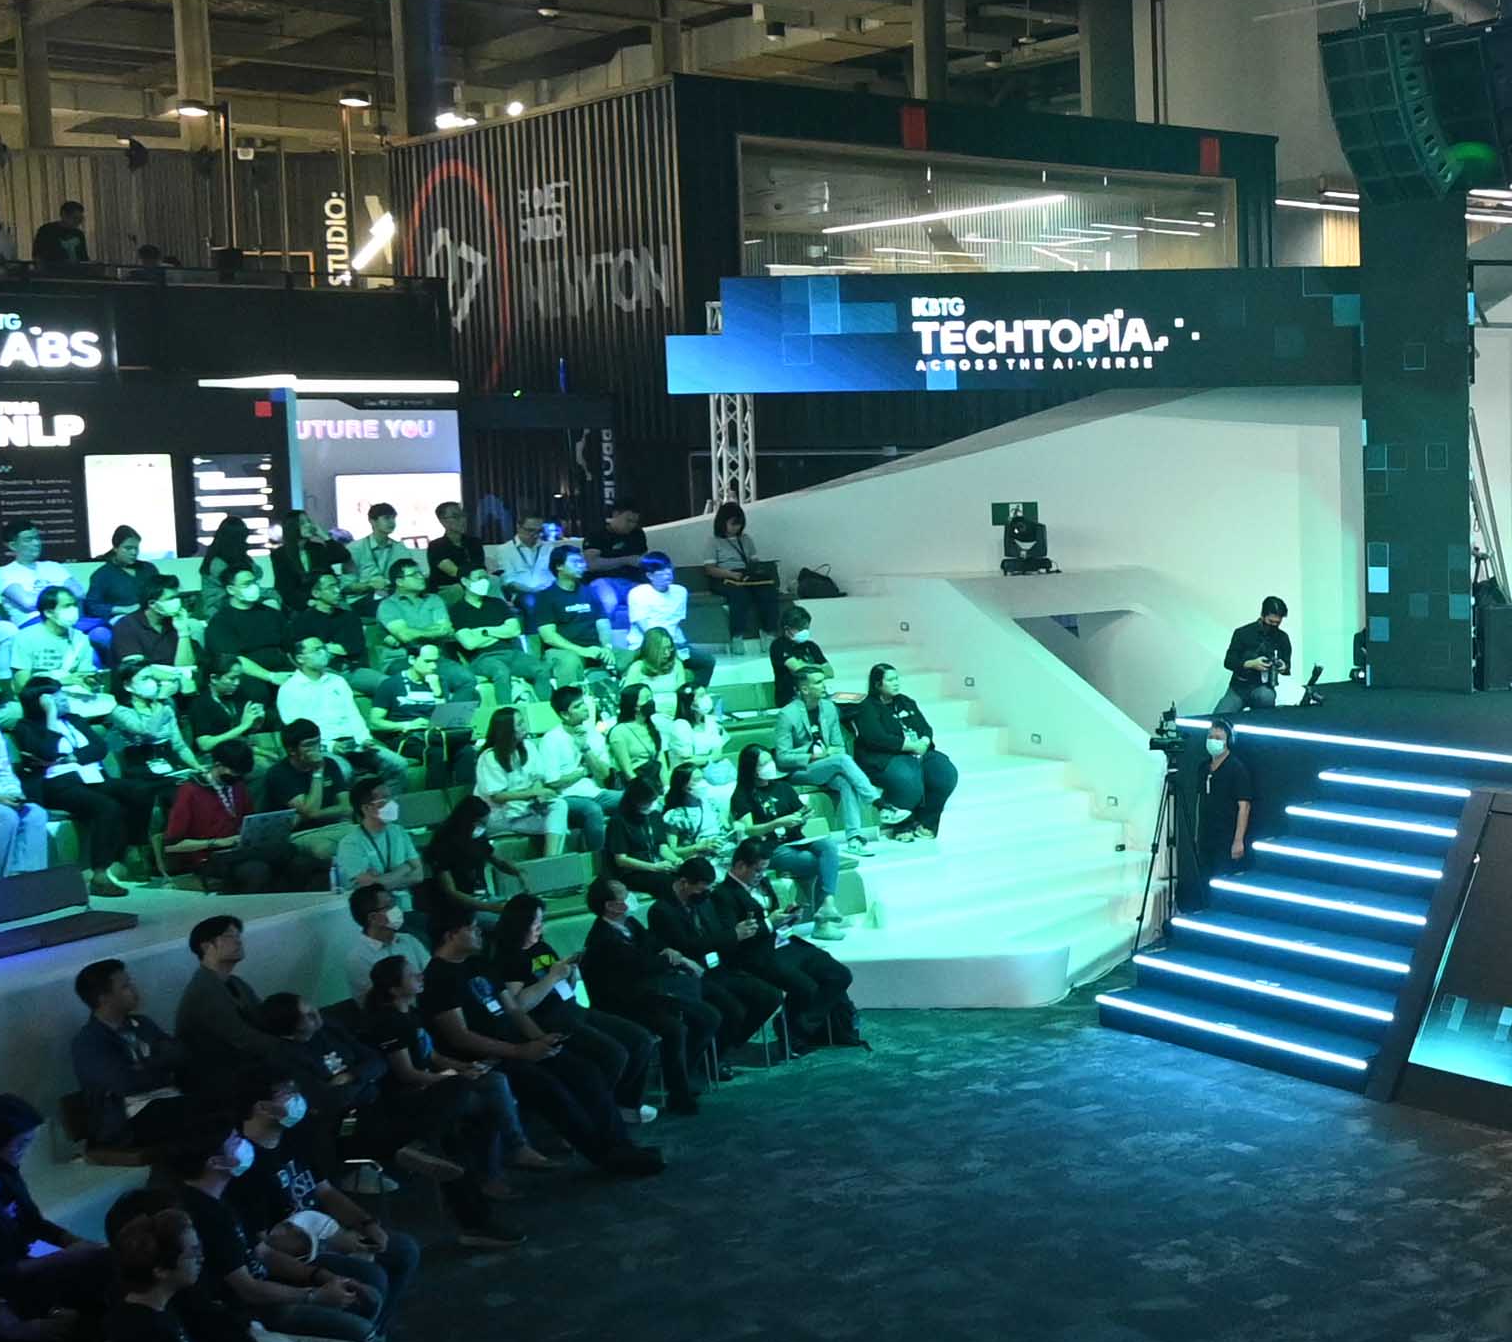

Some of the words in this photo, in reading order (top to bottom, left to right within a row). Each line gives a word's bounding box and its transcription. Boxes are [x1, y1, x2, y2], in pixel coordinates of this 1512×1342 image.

[911, 297, 966, 317] KBTG
[915, 358, 998, 371] ACROSS
[1006, 358, 1045, 371] THE
[295, 419, 380, 440] UTURE
[384, 419, 435, 440] YOU
